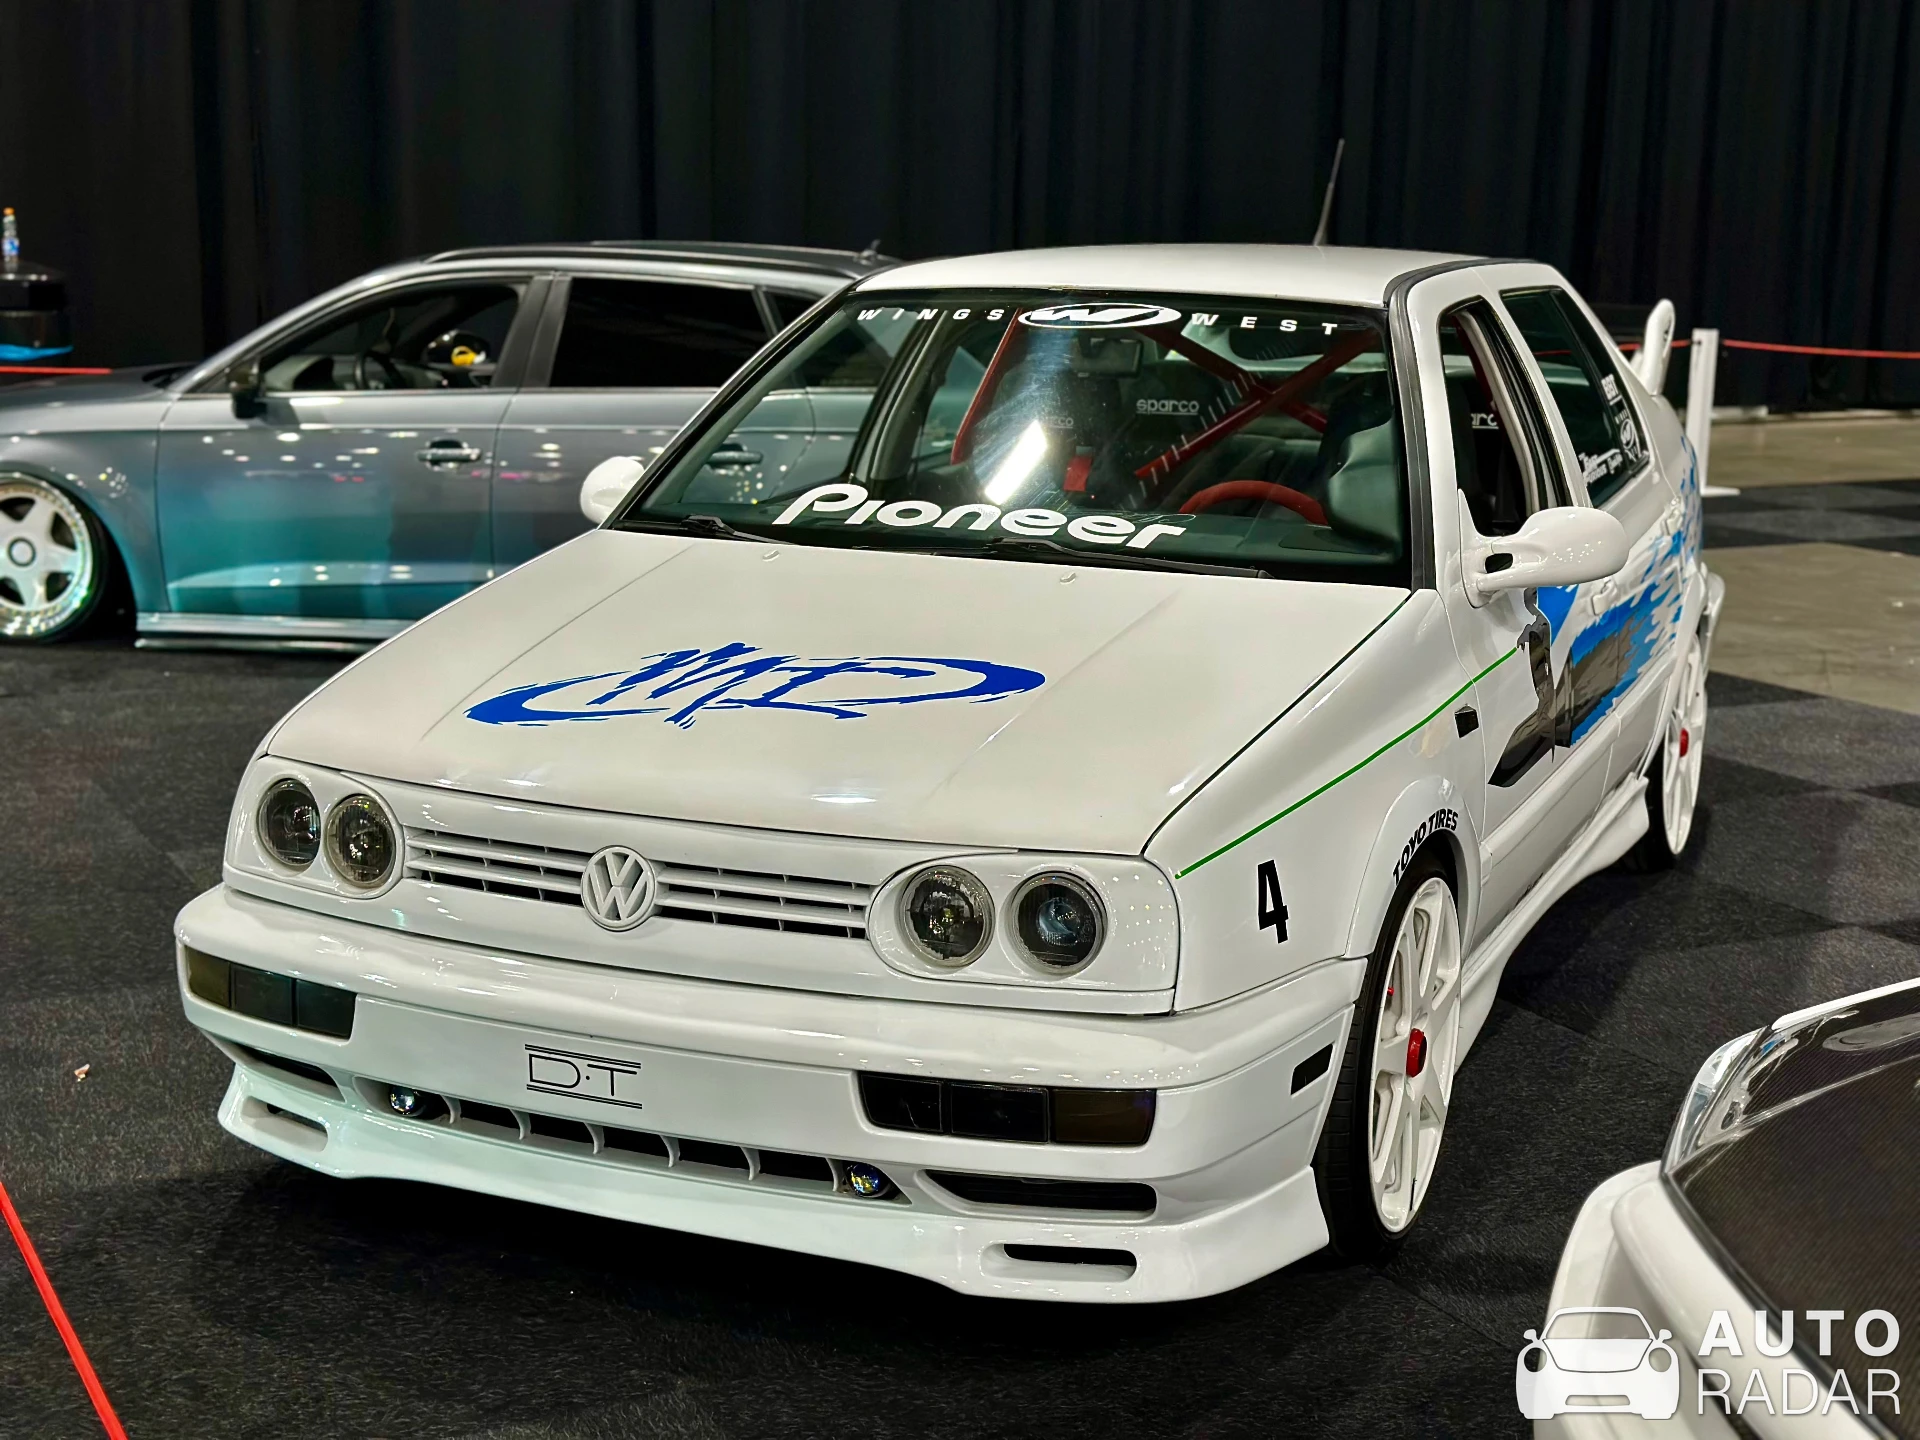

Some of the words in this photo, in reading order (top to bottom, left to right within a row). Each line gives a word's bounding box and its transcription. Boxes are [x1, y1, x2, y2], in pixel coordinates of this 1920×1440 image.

[857, 308, 1004, 321] WINGS
[1192, 312, 1338, 336] WEST
[1135, 398, 1200, 416] sparco
[772, 483, 1187, 549] Pioneer
[1393, 821, 1427, 886] TOYO
[1428, 808, 1459, 832] TIRES
[583, 847, 654, 930] VW
[1257, 859, 1289, 944] 4
